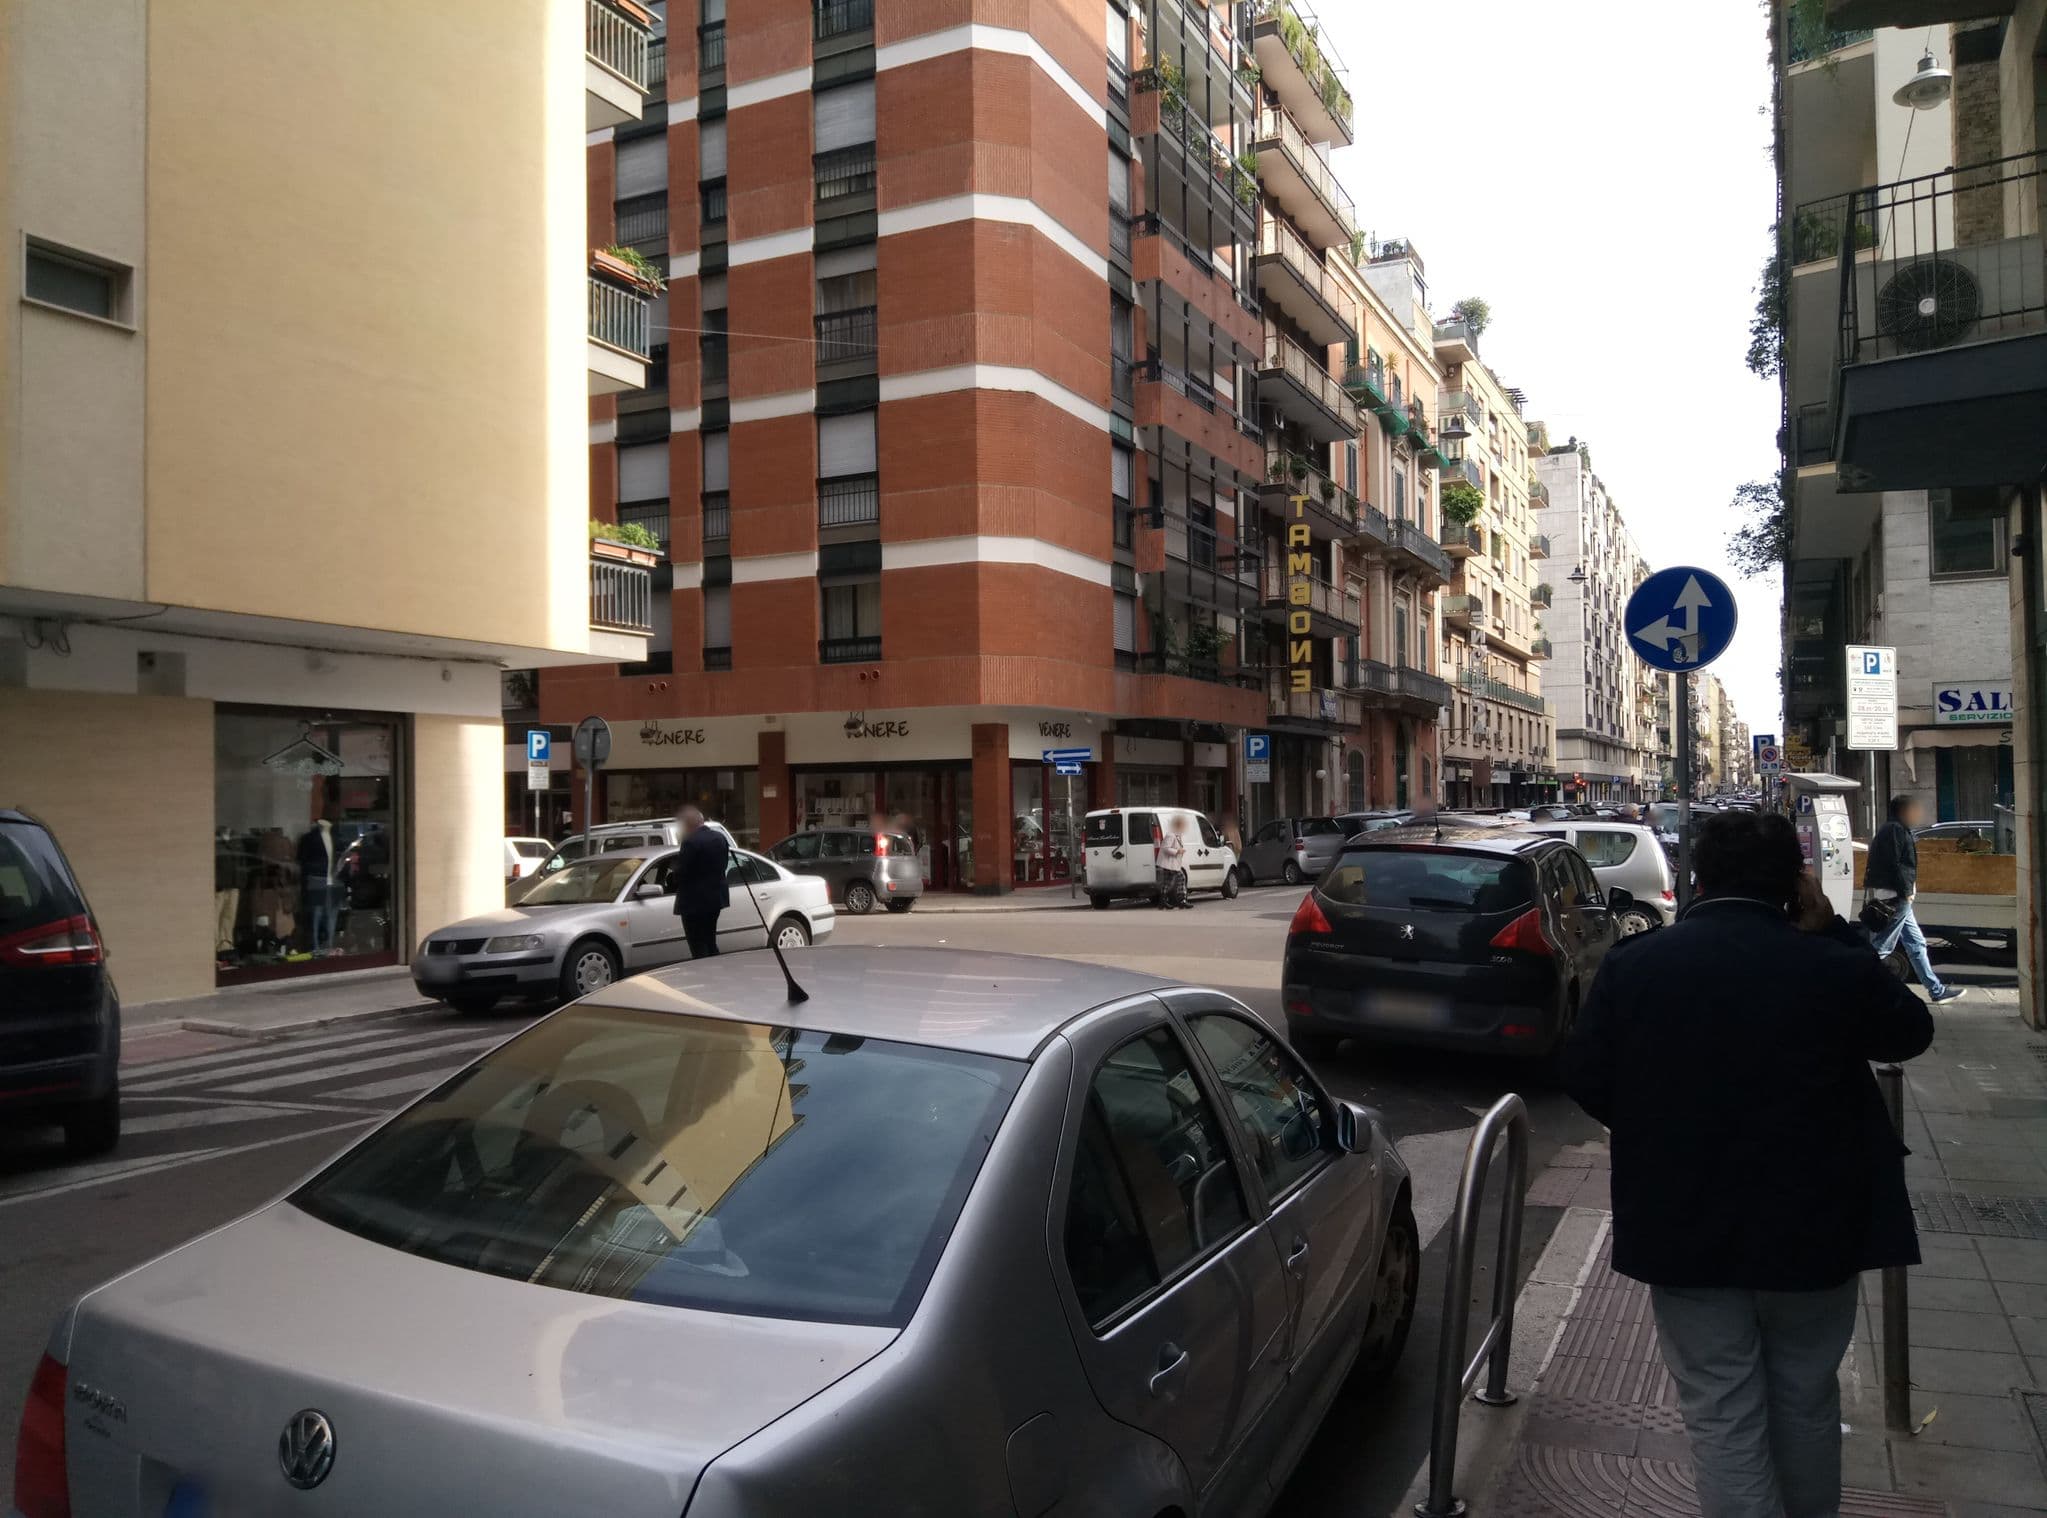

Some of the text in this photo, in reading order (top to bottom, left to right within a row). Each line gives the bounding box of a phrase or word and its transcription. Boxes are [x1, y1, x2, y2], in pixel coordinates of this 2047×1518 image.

[1866, 653, 1877, 673] P
[1039, 721, 1071, 739] VENERE
[532, 734, 546, 758] P
[1250, 738, 1265, 757] P
[1801, 795, 1811, 813] P
